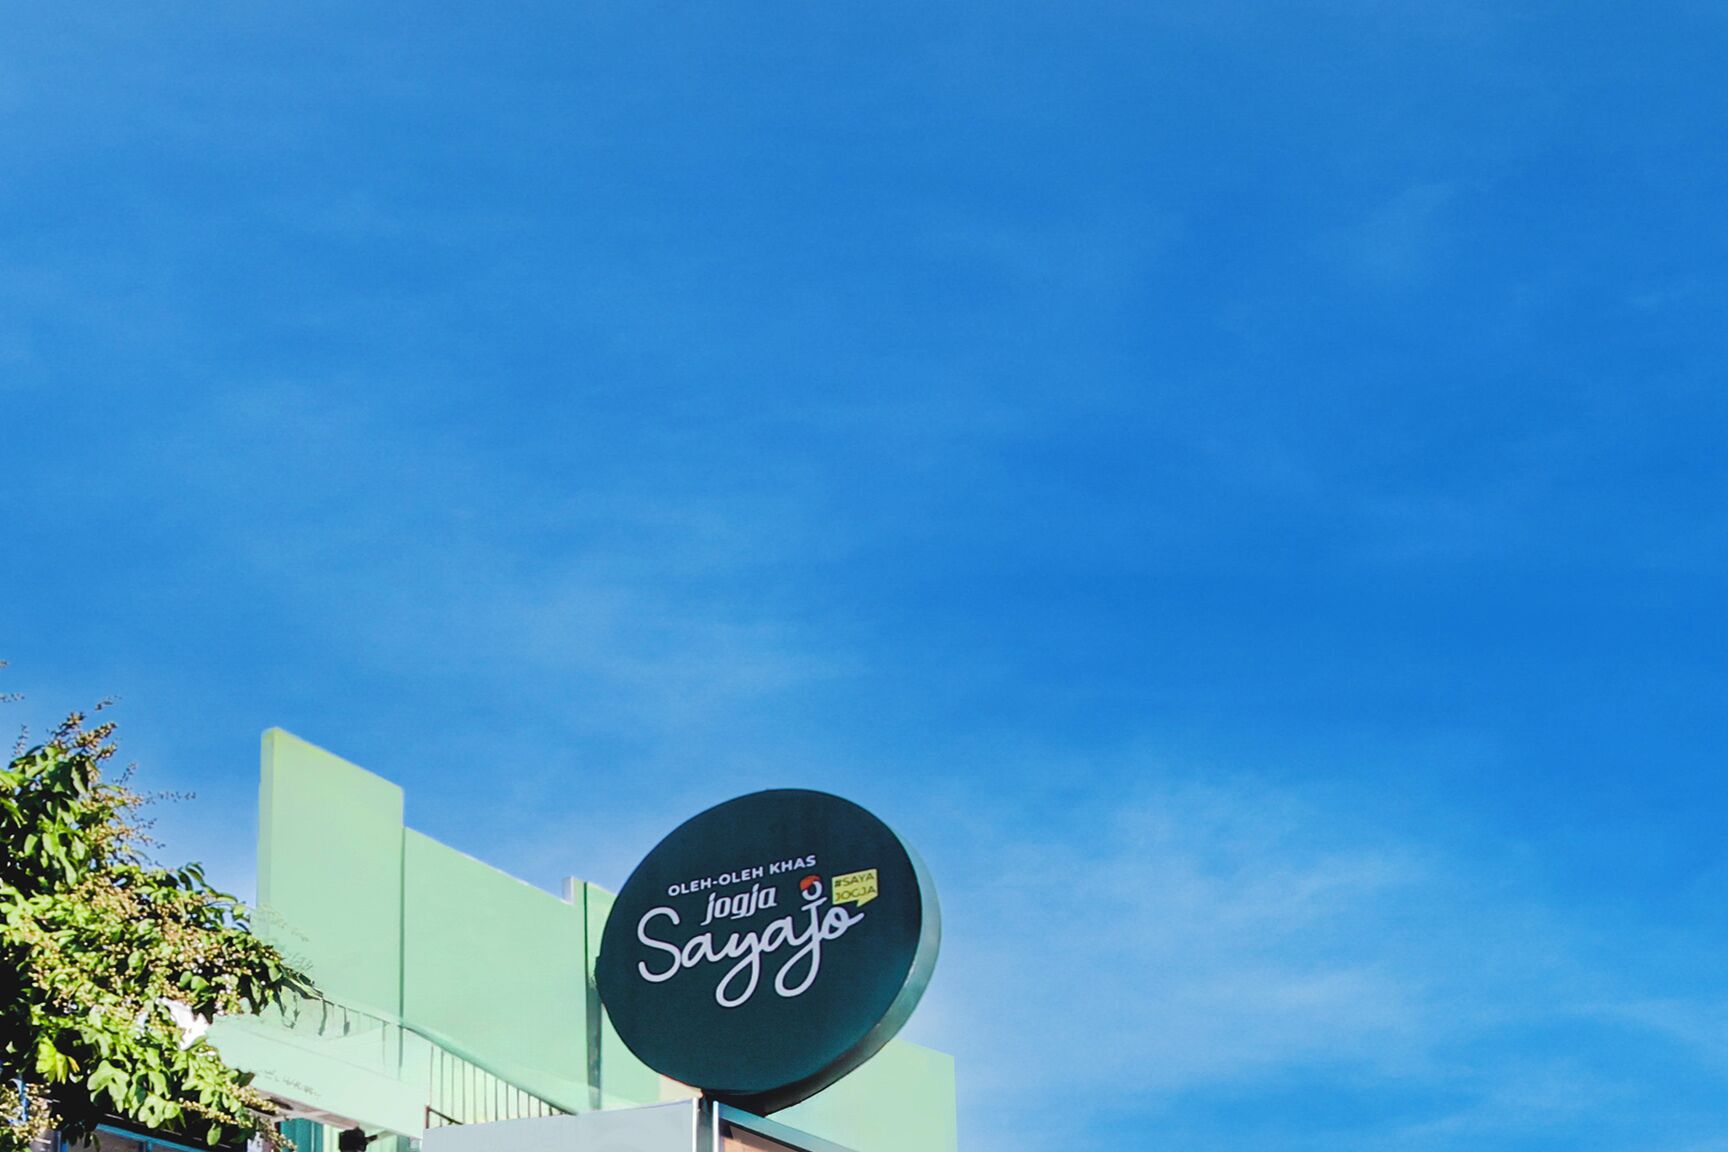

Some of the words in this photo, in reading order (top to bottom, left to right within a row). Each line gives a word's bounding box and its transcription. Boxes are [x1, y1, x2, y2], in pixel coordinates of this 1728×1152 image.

[668, 866, 764, 897] OLEH-OLEH
[769, 854, 817, 876] KHAS
[834, 872, 875, 888] #SAYA
